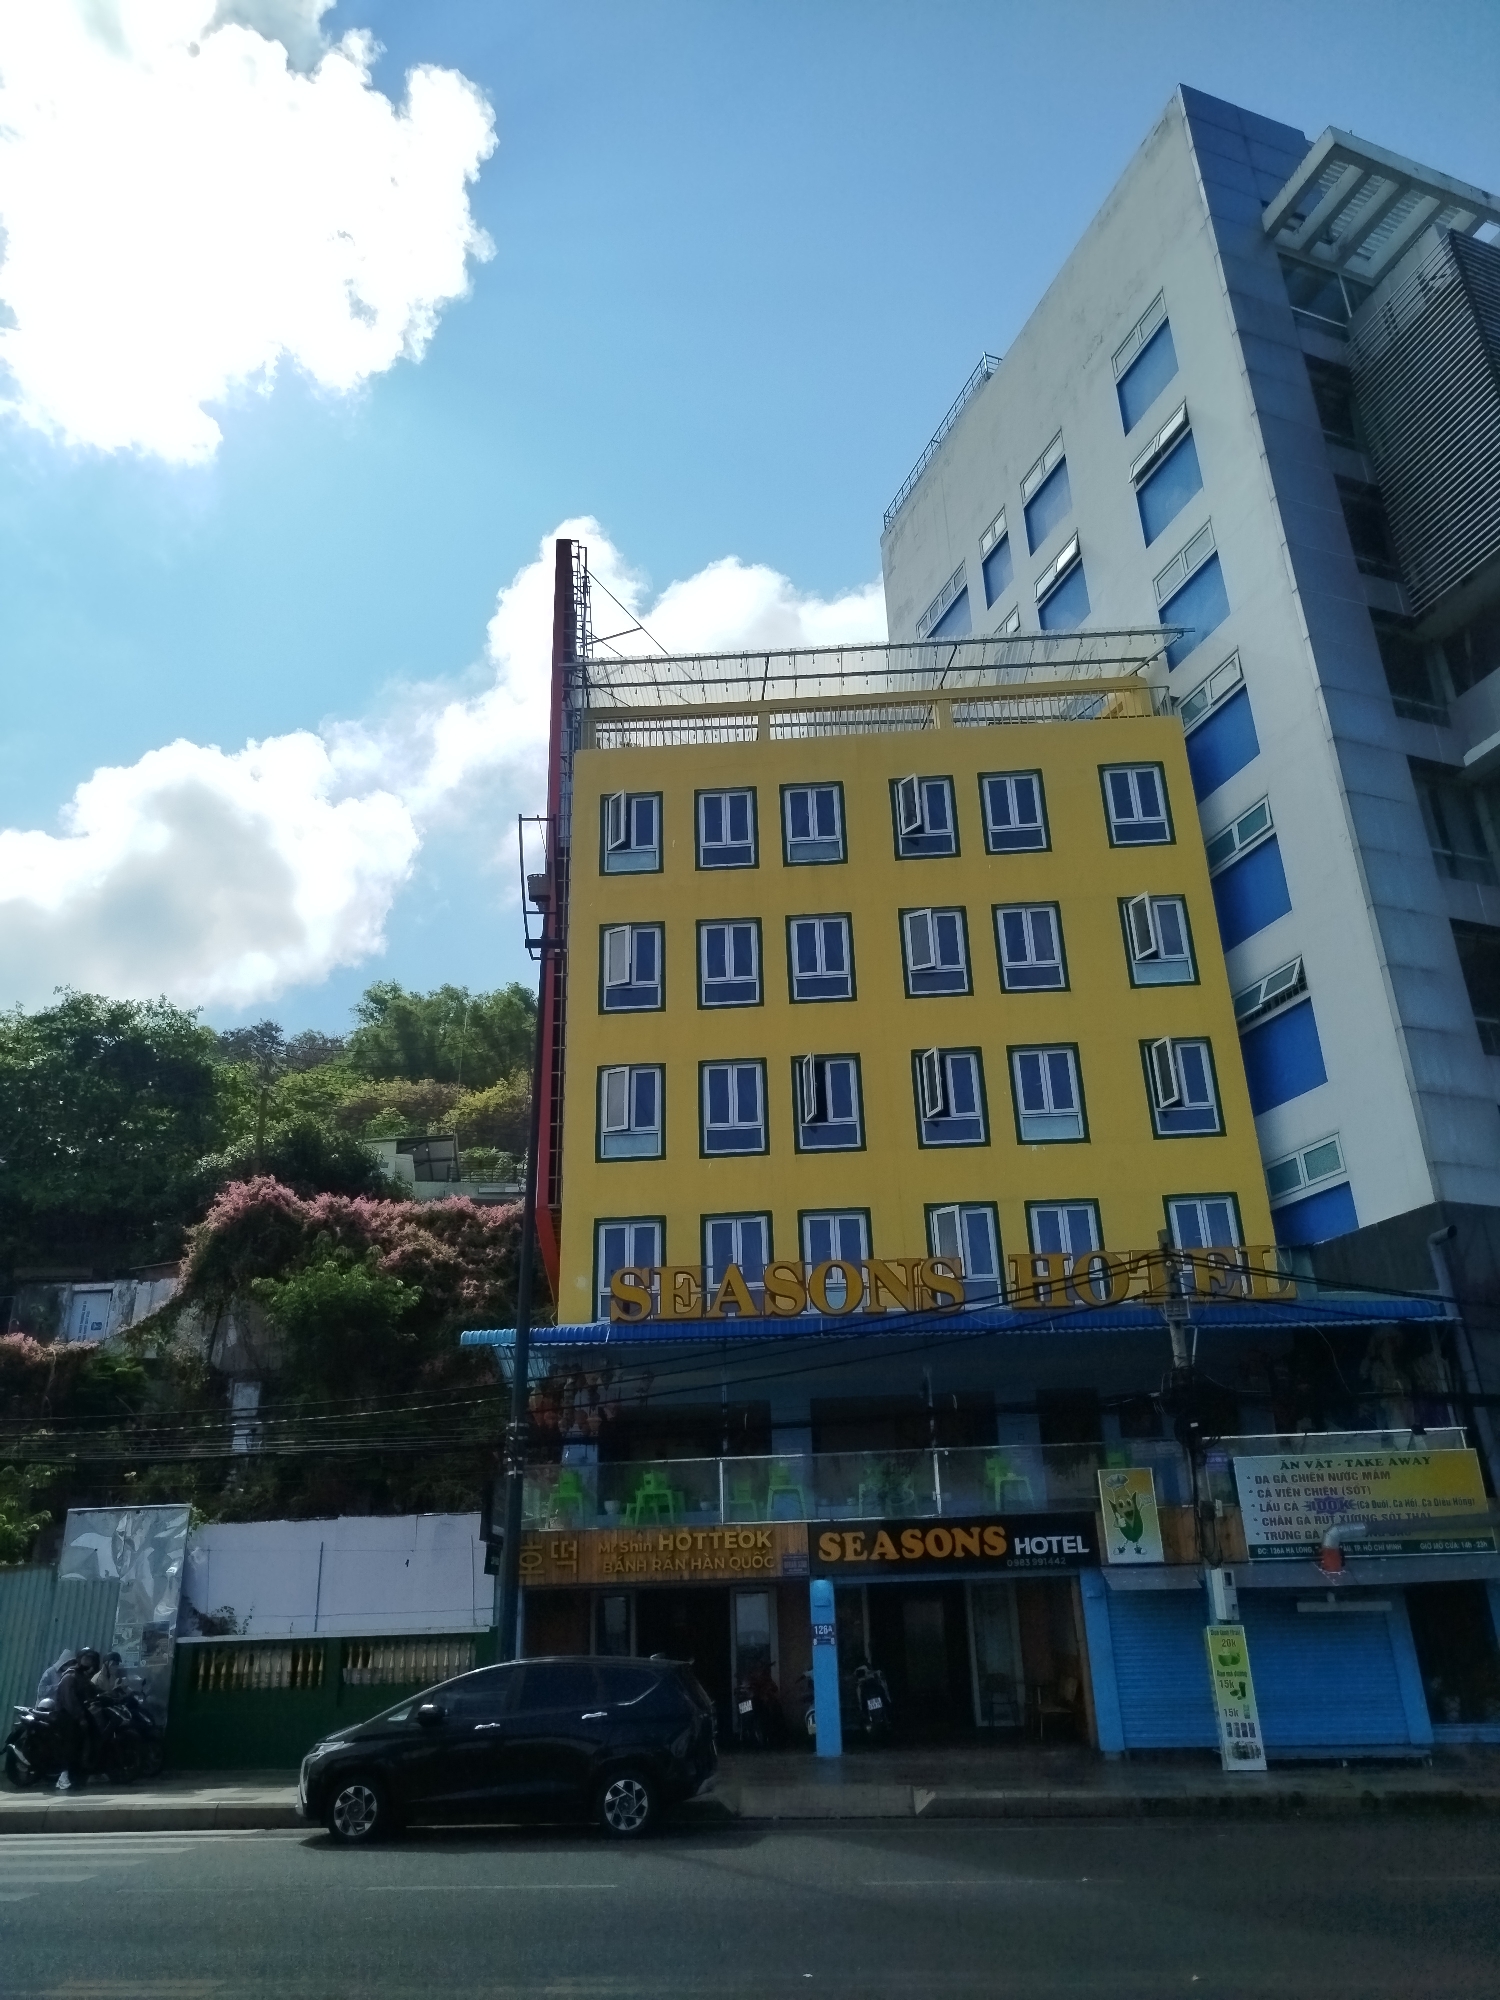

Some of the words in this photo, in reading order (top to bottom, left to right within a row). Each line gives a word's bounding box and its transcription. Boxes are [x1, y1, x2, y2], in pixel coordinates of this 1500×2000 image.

[610, 1257, 966, 1325] SEASONS
[1008, 1244, 1297, 1312] HOTEL
[1280, 1459, 1300, 1470] ĂN
[1303, 1458, 1333, 1471] VẶT
[1345, 1457, 1384, 1468] TAKE
[1388, 1456, 1431, 1467] AWAY
[1254, 1475, 1270, 1485] DA
[1273, 1472, 1288, 1484] GÀ
[1291, 1472, 1325, 1483] CHIÊN
[1328, 1470, 1359, 1482] NƯỚC
[1257, 1487, 1273, 1498] CÁ
[1274, 1486, 1301, 1498] VIÊN
[1304, 1485, 1338, 1497] CHIÊN
[1259, 1499, 1281, 1512] LẨU
[1262, 1514, 1293, 1527] CHÂN
[1296, 1513, 1312, 1525] GÀ
[1304, 1528, 1320, 1540] GÀ
[597, 1542, 618, 1554] Mr
[620, 1540, 653, 1553] Shin
[658, 1530, 773, 1551] HOTTEOK
[817, 1525, 1008, 1562] SEASONS
[1014, 1535, 1091, 1556] HOTEL
[602, 1555, 648, 1574] BÁNH
[652, 1553, 687, 1571] RÁN
[691, 1552, 725, 1570] HÀN
[729, 1550, 775, 1571] QUỐC
[1219, 1679, 1235, 1689] 15k
[1223, 1708, 1240, 1718] 15k
